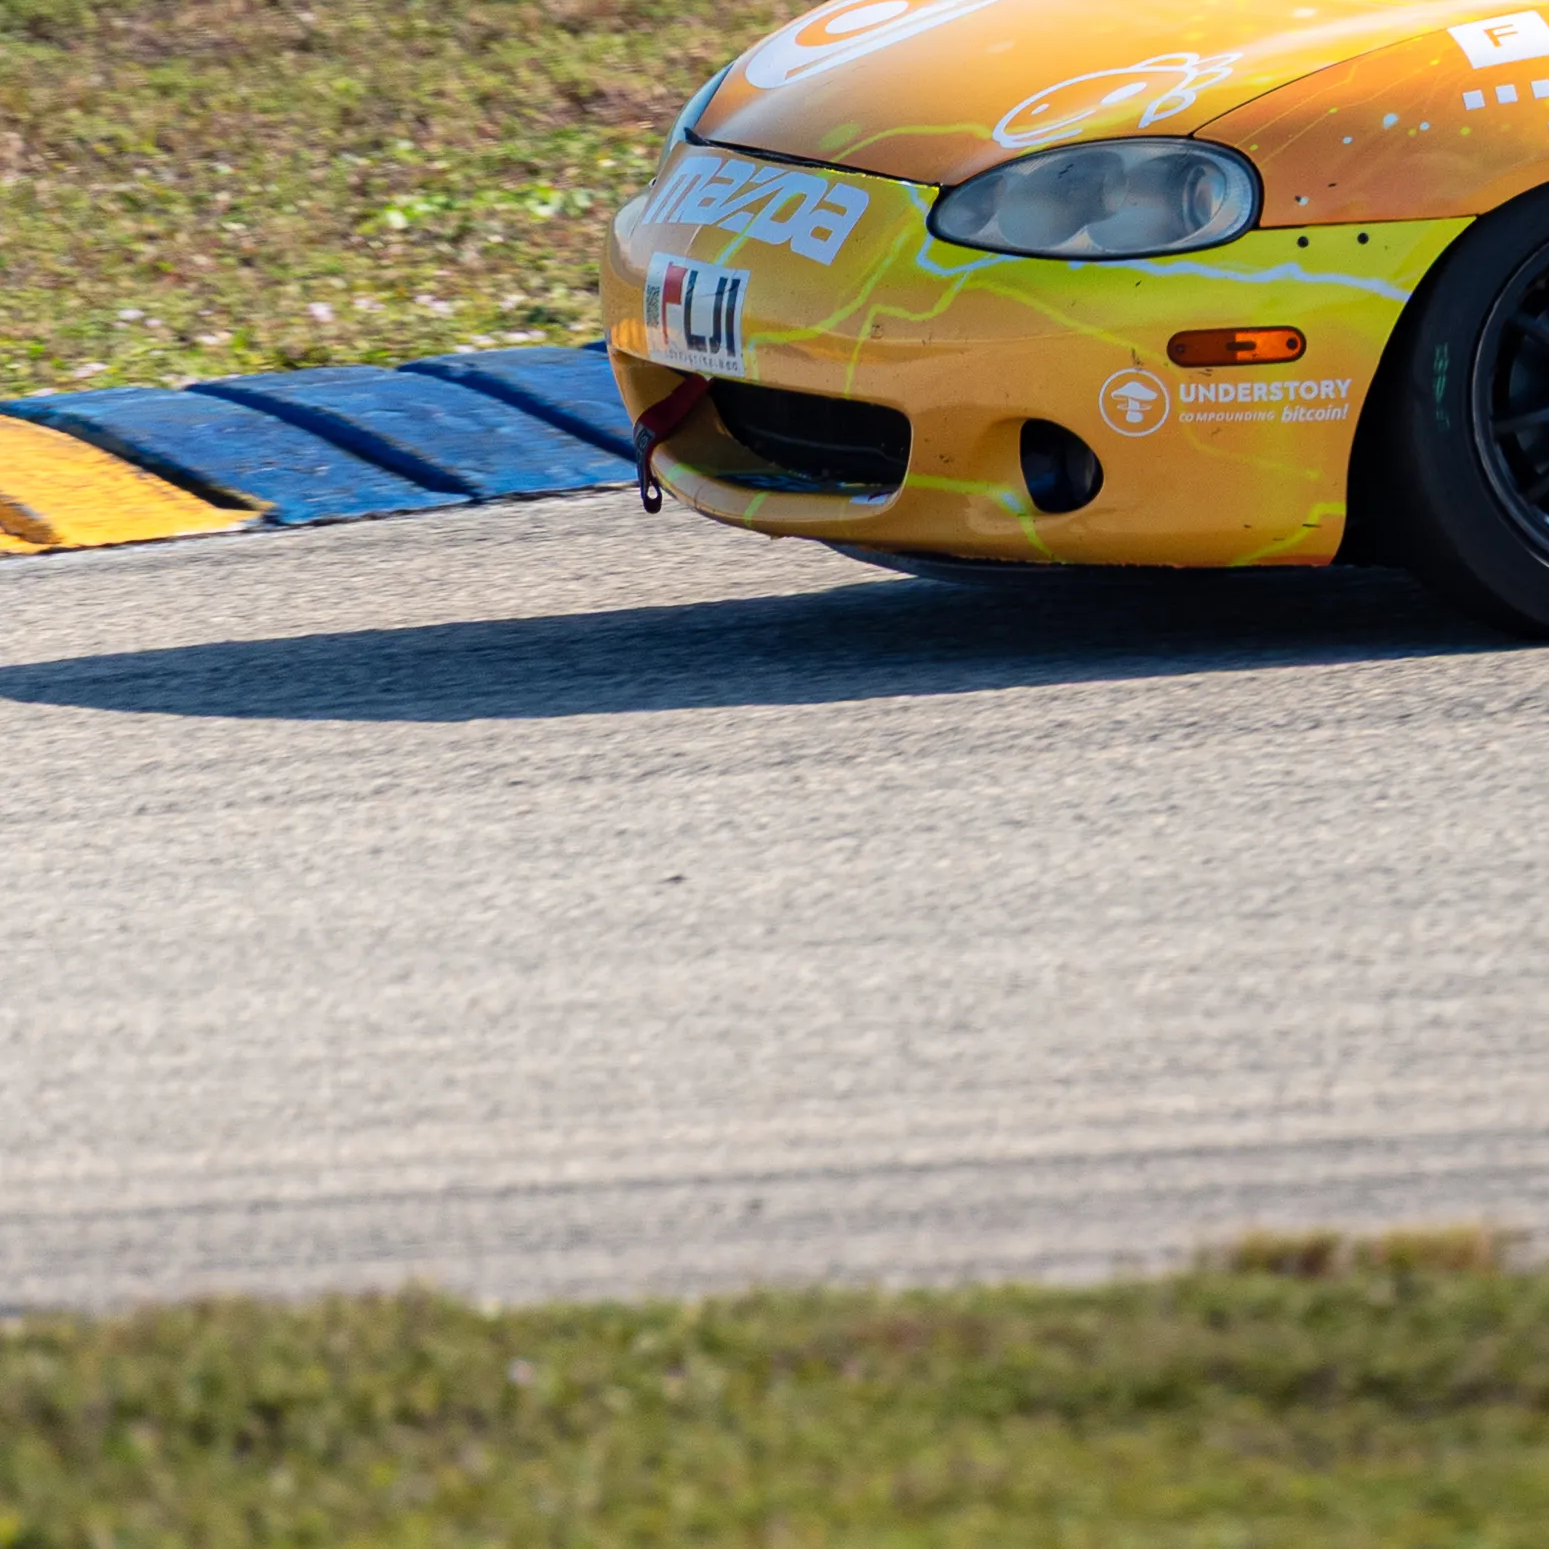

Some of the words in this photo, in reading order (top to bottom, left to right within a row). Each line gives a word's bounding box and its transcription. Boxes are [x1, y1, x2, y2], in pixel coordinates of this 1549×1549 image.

[1179, 379, 1352, 403] UNDERSTORY
[1178, 411, 1275, 423] COMPOUNDING
[1281, 403, 1350, 424] bitcoin!
